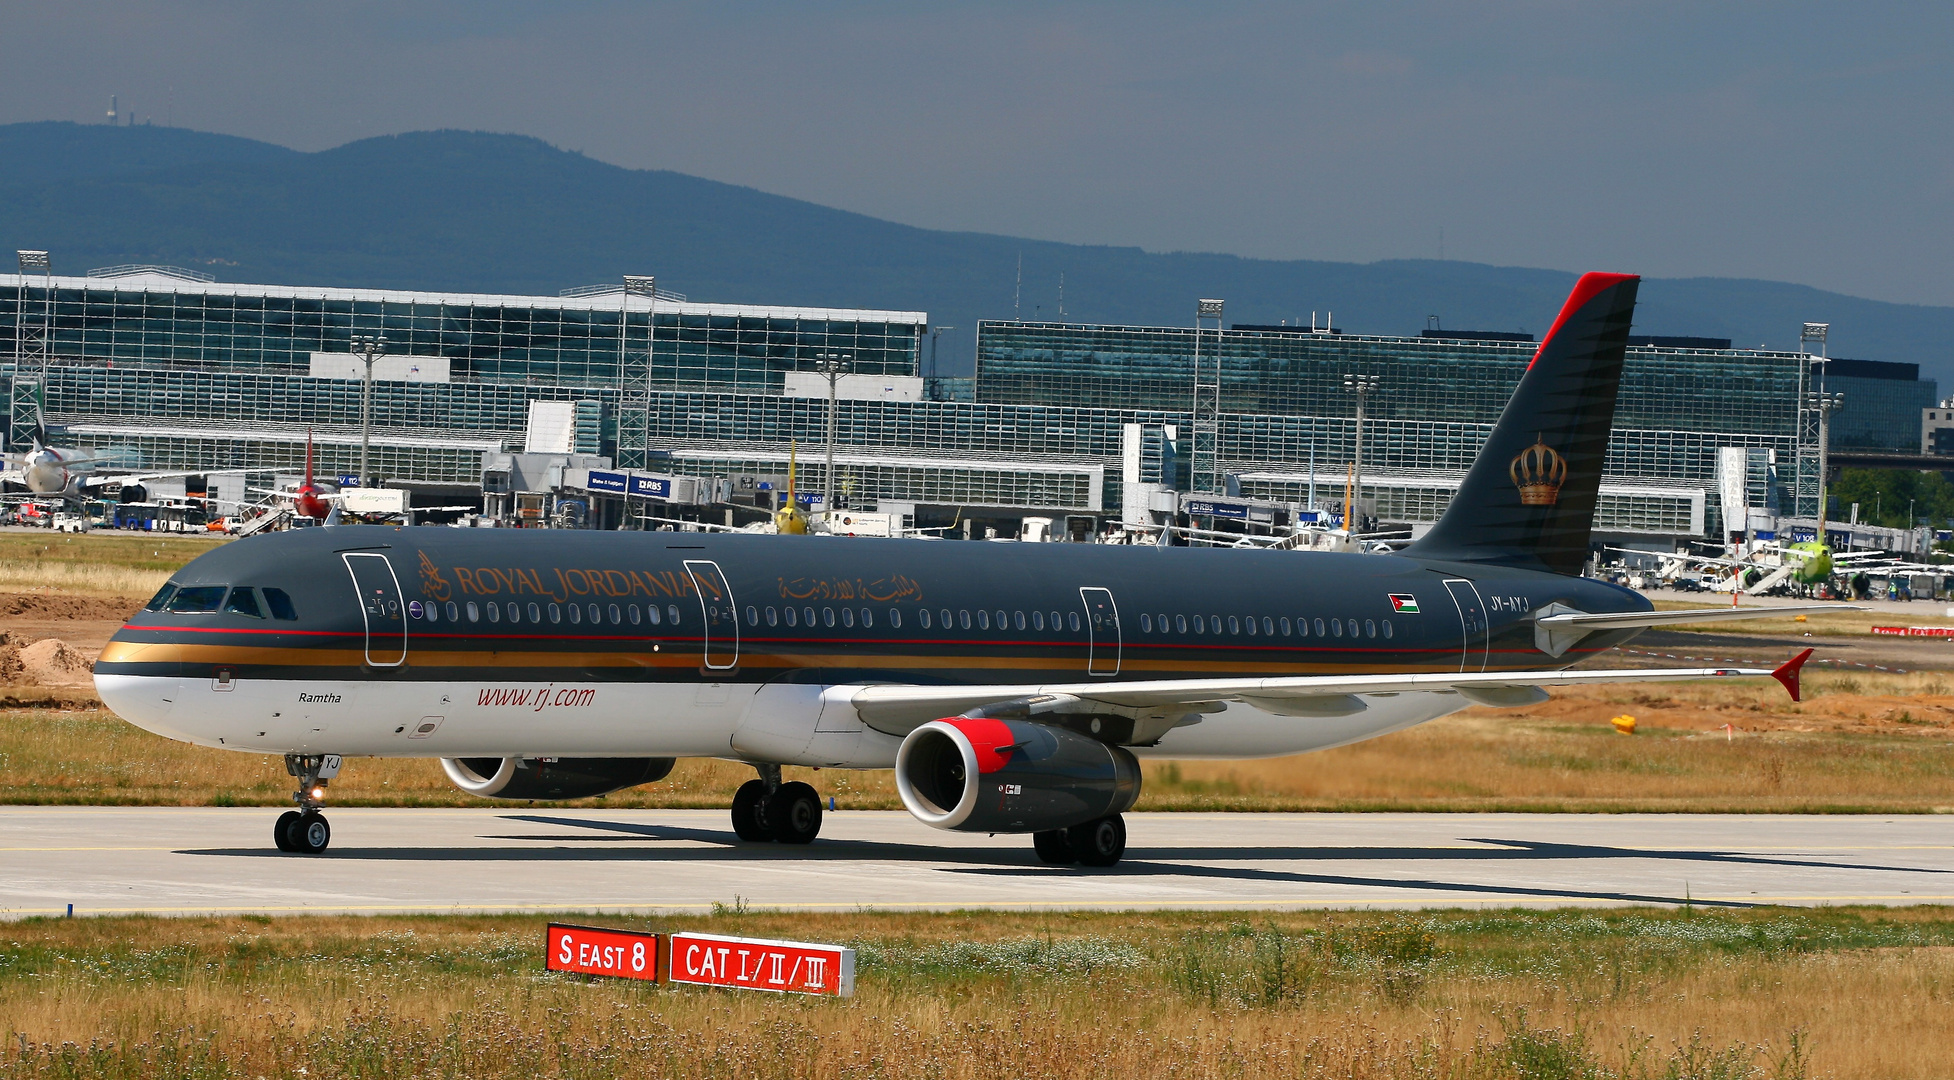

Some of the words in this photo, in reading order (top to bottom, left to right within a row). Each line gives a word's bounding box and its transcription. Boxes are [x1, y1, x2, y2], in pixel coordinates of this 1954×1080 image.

[348, 477, 358, 485] 112
[646, 481, 662, 491] RBS
[1199, 503, 1214, 512] RBS
[453, 567, 554, 595] ROYAL
[553, 568, 722, 604] JORDANIAN
[1491, 596, 1529, 613] JY-AYJ
[298, 692, 342, 704] Ramtha
[477, 683, 596, 712] www.rj.com
[326, 757, 340, 769] YJ
[558, 935, 573, 964] S
[579, 943, 624, 970] EAST
[631, 941, 646, 972] 8
[686, 944, 730, 978] CAT
[736, 949, 827, 988] I/II/III
